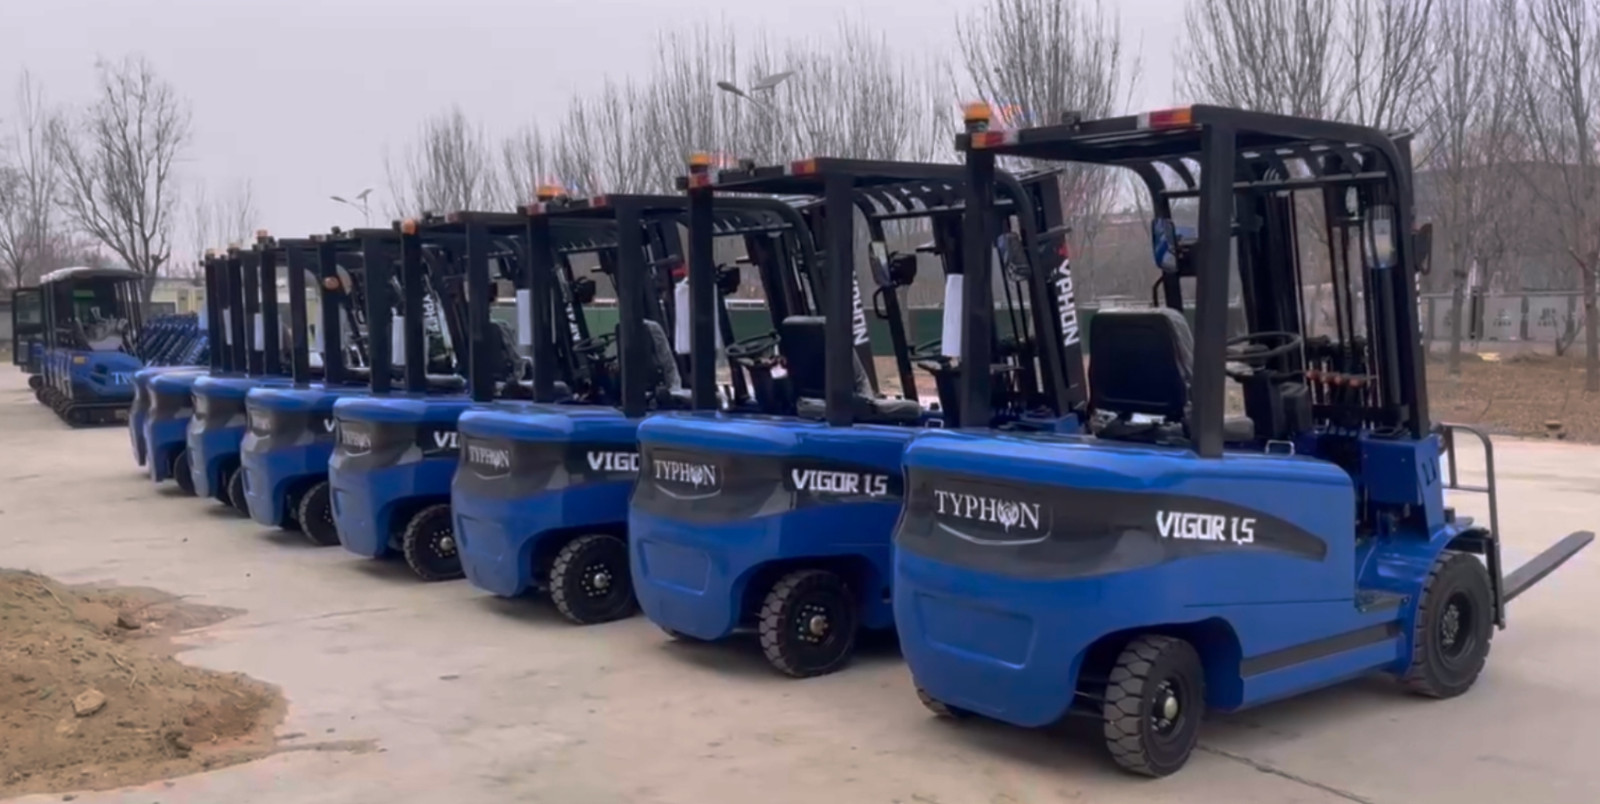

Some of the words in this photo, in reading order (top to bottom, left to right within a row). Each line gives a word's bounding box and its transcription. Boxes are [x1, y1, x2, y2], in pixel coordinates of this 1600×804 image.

[653, 459, 716, 489] TYPHON
[791, 468, 859, 493] VIGOR
[934, 489, 1040, 533] TYPHON
[1156, 510, 1226, 541] VIGOR
